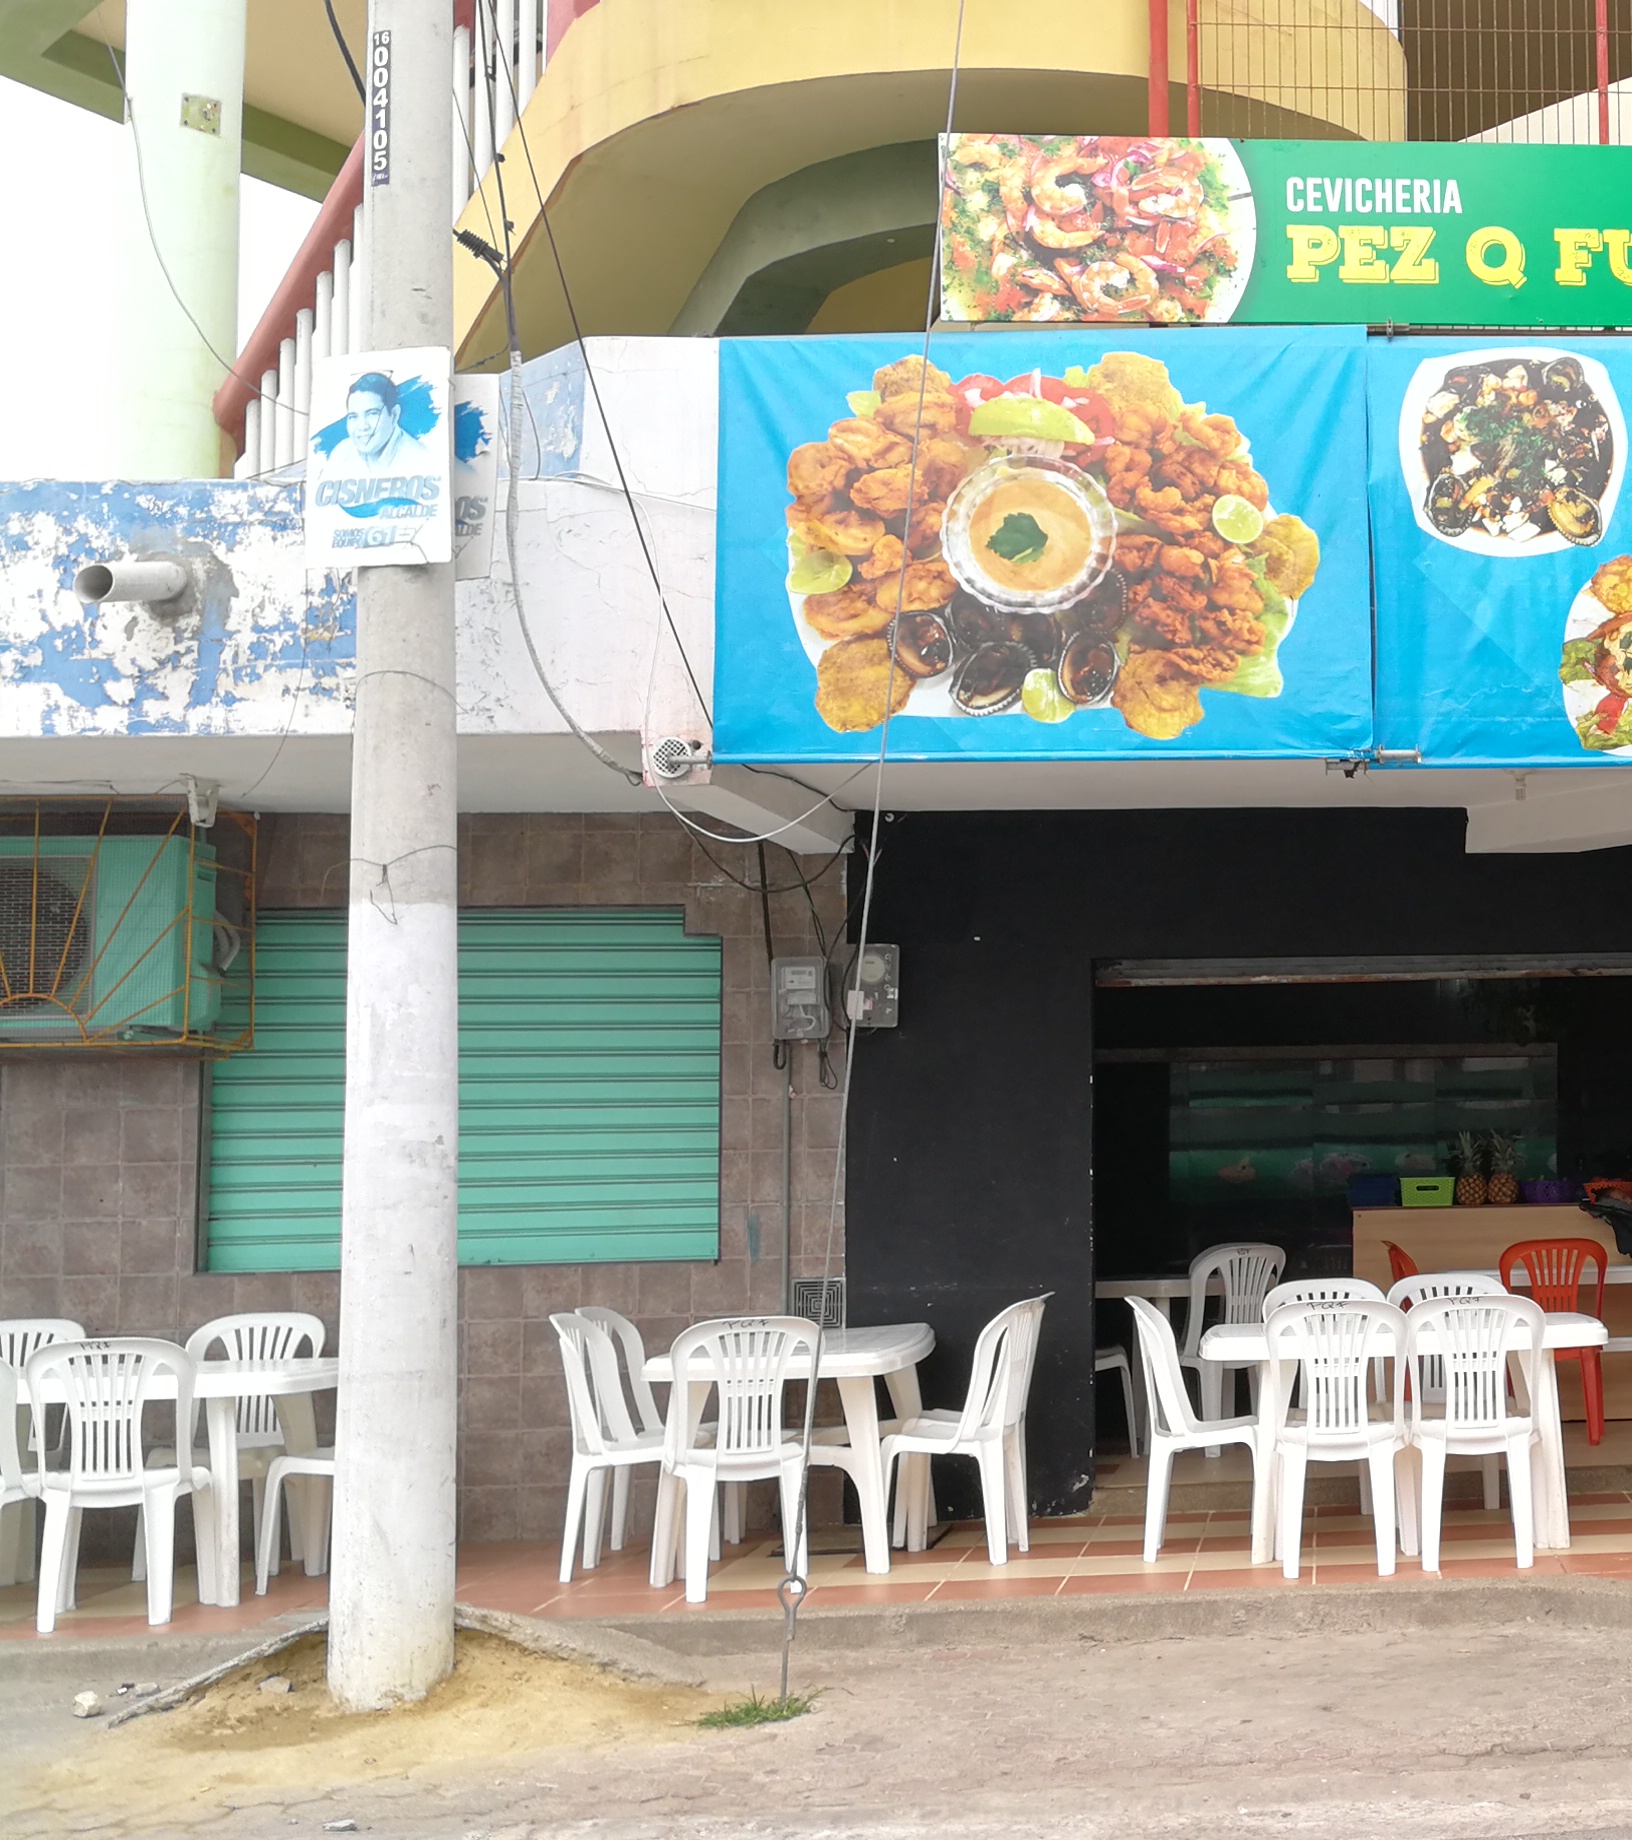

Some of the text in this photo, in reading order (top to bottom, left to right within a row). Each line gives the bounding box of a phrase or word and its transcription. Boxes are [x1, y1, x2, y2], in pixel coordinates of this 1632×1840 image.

[374, 31, 390, 45] 16
[373, 46, 389, 171] 004105
[1286, 176, 1463, 214] CEVICHERIA
[1286, 224, 1440, 285] PEZ
[1465, 225, 1528, 290] Q
[315, 475, 442, 507] CISNEROS
[379, 503, 439, 520] ALCALDE
